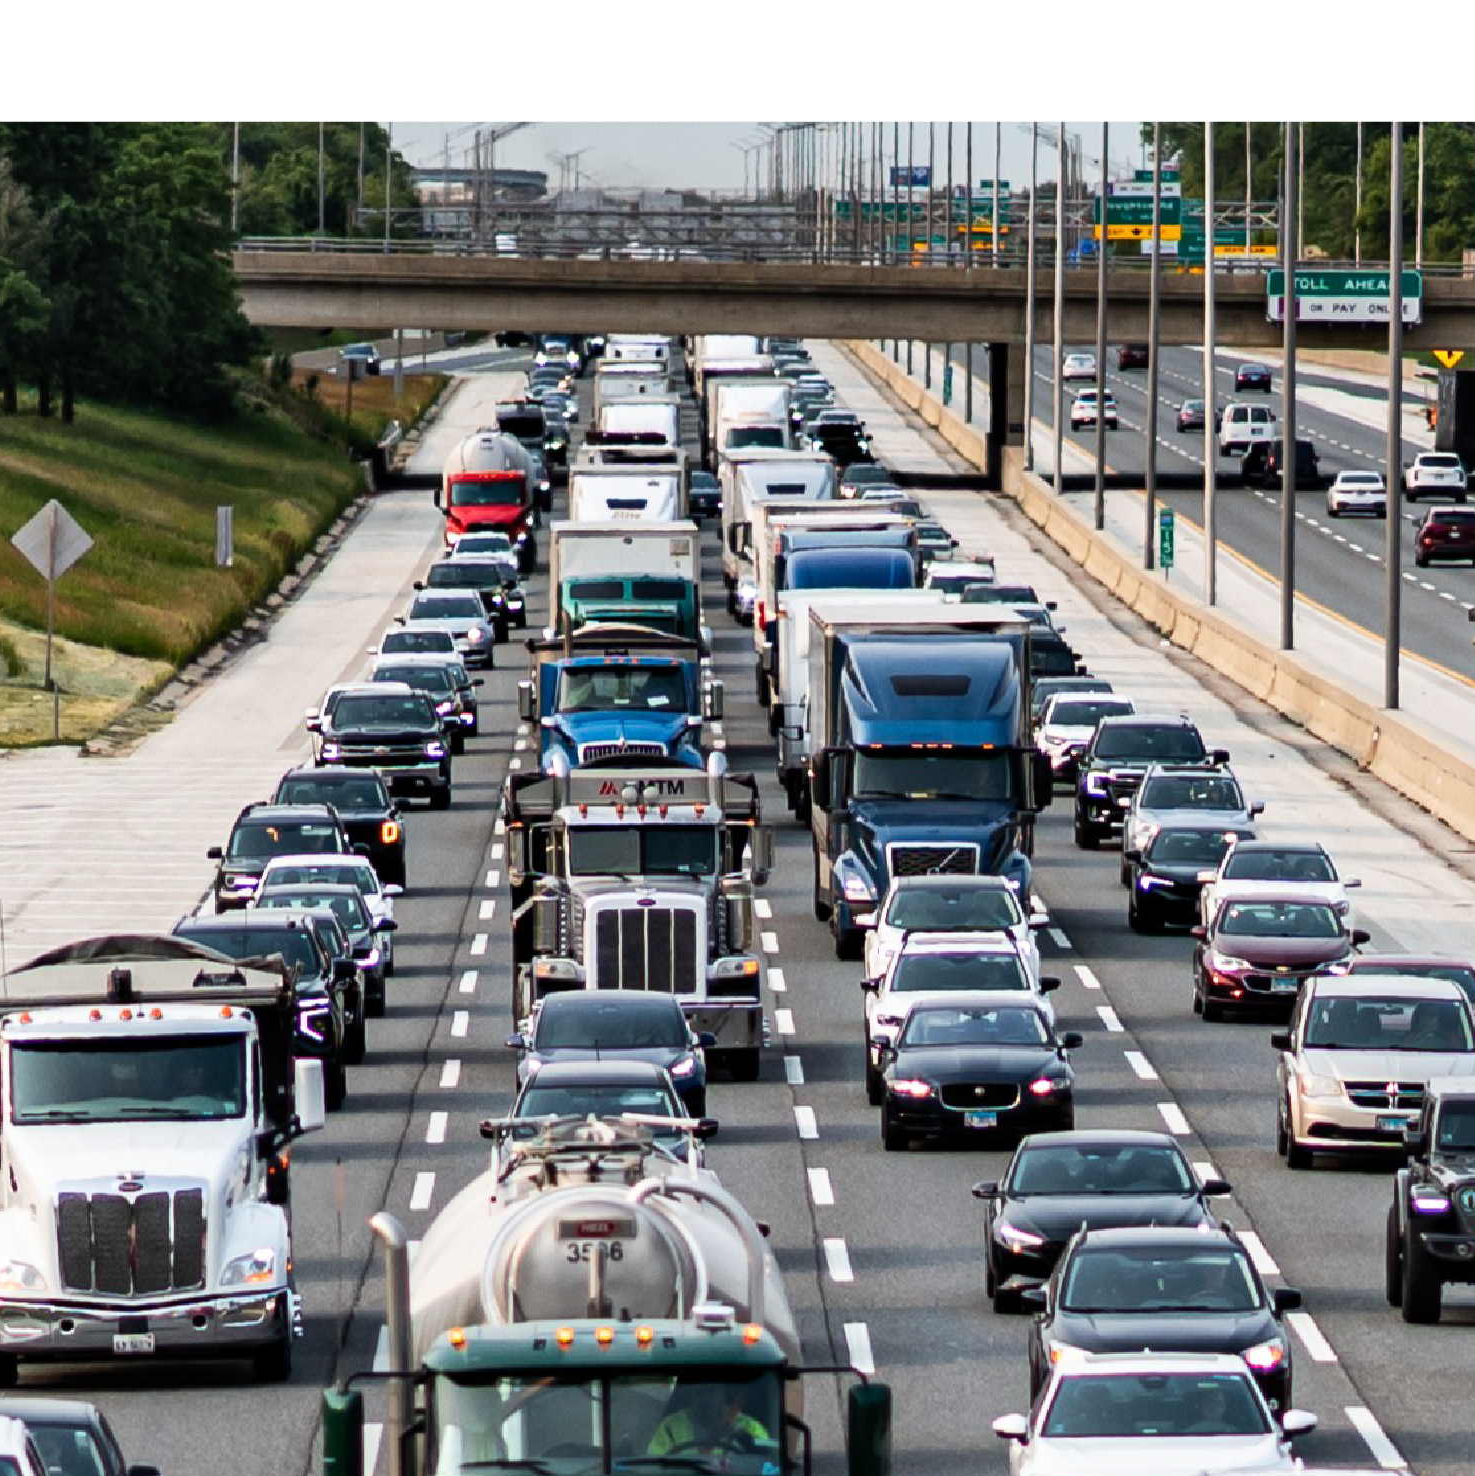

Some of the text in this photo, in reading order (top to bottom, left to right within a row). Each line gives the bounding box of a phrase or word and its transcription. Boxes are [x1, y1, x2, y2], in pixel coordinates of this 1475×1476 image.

[1294, 277, 1390, 290] TOLL AHEA
[1332, 304, 1356, 313] PAY
[1368, 304, 1409, 315] ONLE
